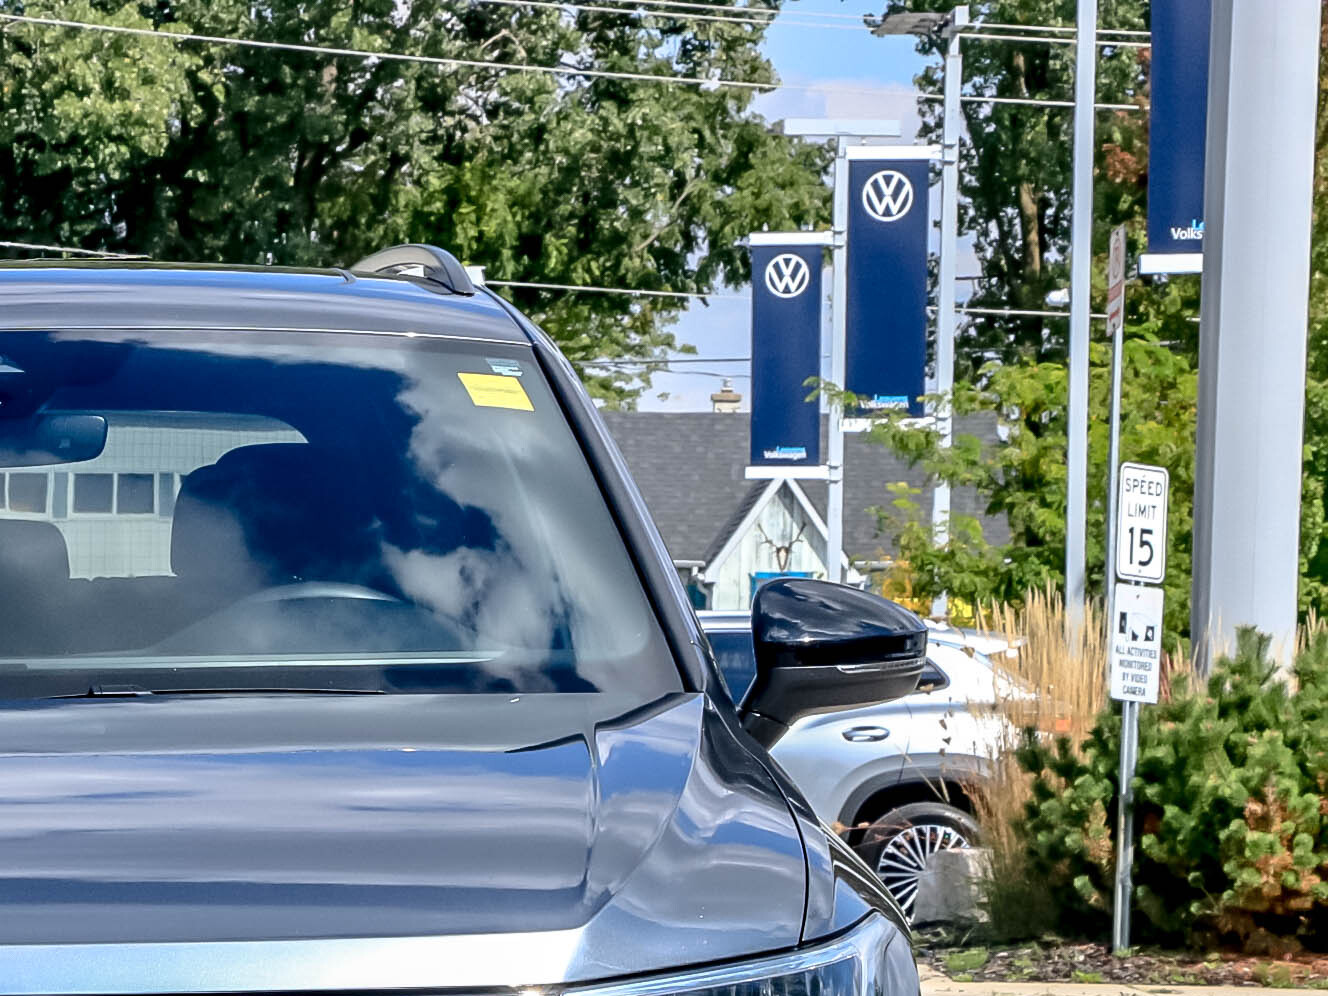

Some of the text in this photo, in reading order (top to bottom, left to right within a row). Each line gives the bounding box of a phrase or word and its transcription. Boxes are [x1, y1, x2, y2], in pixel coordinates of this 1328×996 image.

[1125, 477, 1163, 497] SPEED
[1127, 501, 1157, 521] LIMIT
[1128, 526, 1154, 567] 15
[1115, 643, 1158, 660] ALL ACTIVITIES
[1118, 659, 1153, 672] MONITORED
[1131, 673, 1148, 685] VIDEO
[1122, 684, 1147, 697] CAMERA
